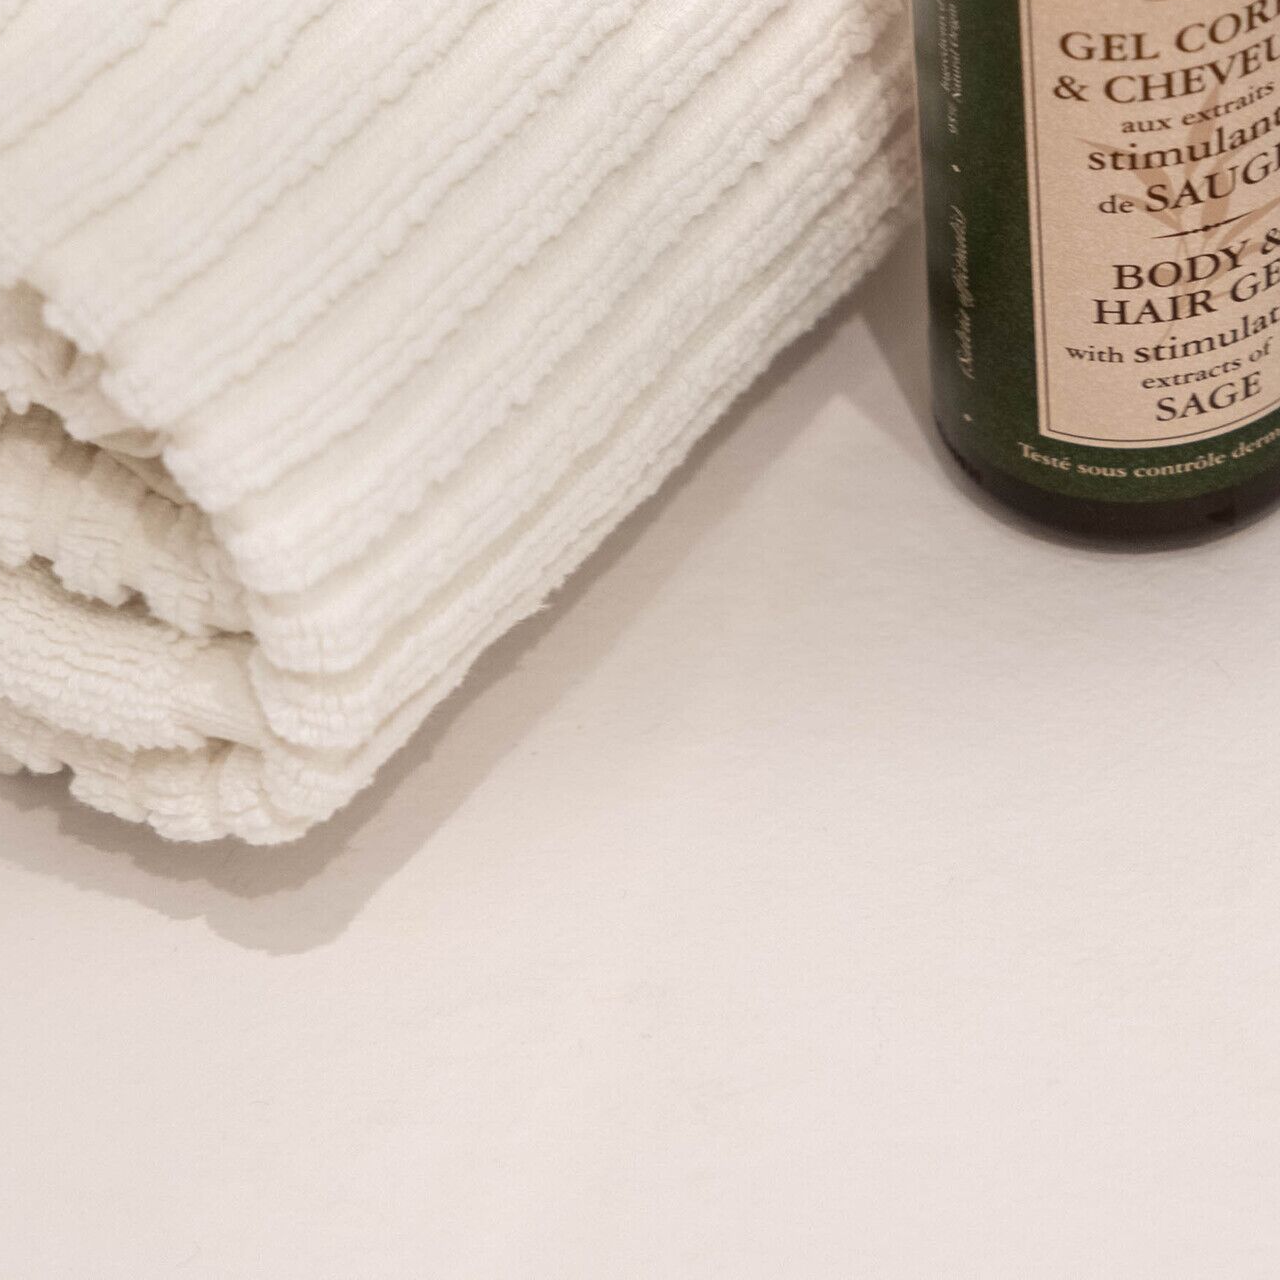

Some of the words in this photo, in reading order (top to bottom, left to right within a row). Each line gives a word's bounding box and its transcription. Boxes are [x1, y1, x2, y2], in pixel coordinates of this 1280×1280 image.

[1059, 31, 1159, 62] GEL
[1053, 75, 1088, 102] &
[1121, 116, 1173, 135] aux
[1182, 80, 1276, 127] extraits
[1098, 195, 1134, 215] de
[1112, 239, 1250, 290] BODY
[1092, 290, 1216, 325] HAIR
[1065, 345, 1124, 364] with
[1141, 357, 1242, 390] extracts
[1249, 336, 1274, 364] of
[1155, 371, 1262, 422] SAGE
[1017, 441, 1070, 471] Testé
[1077, 462, 1127, 478] sous
[1133, 452, 1226, 478] contrôle
